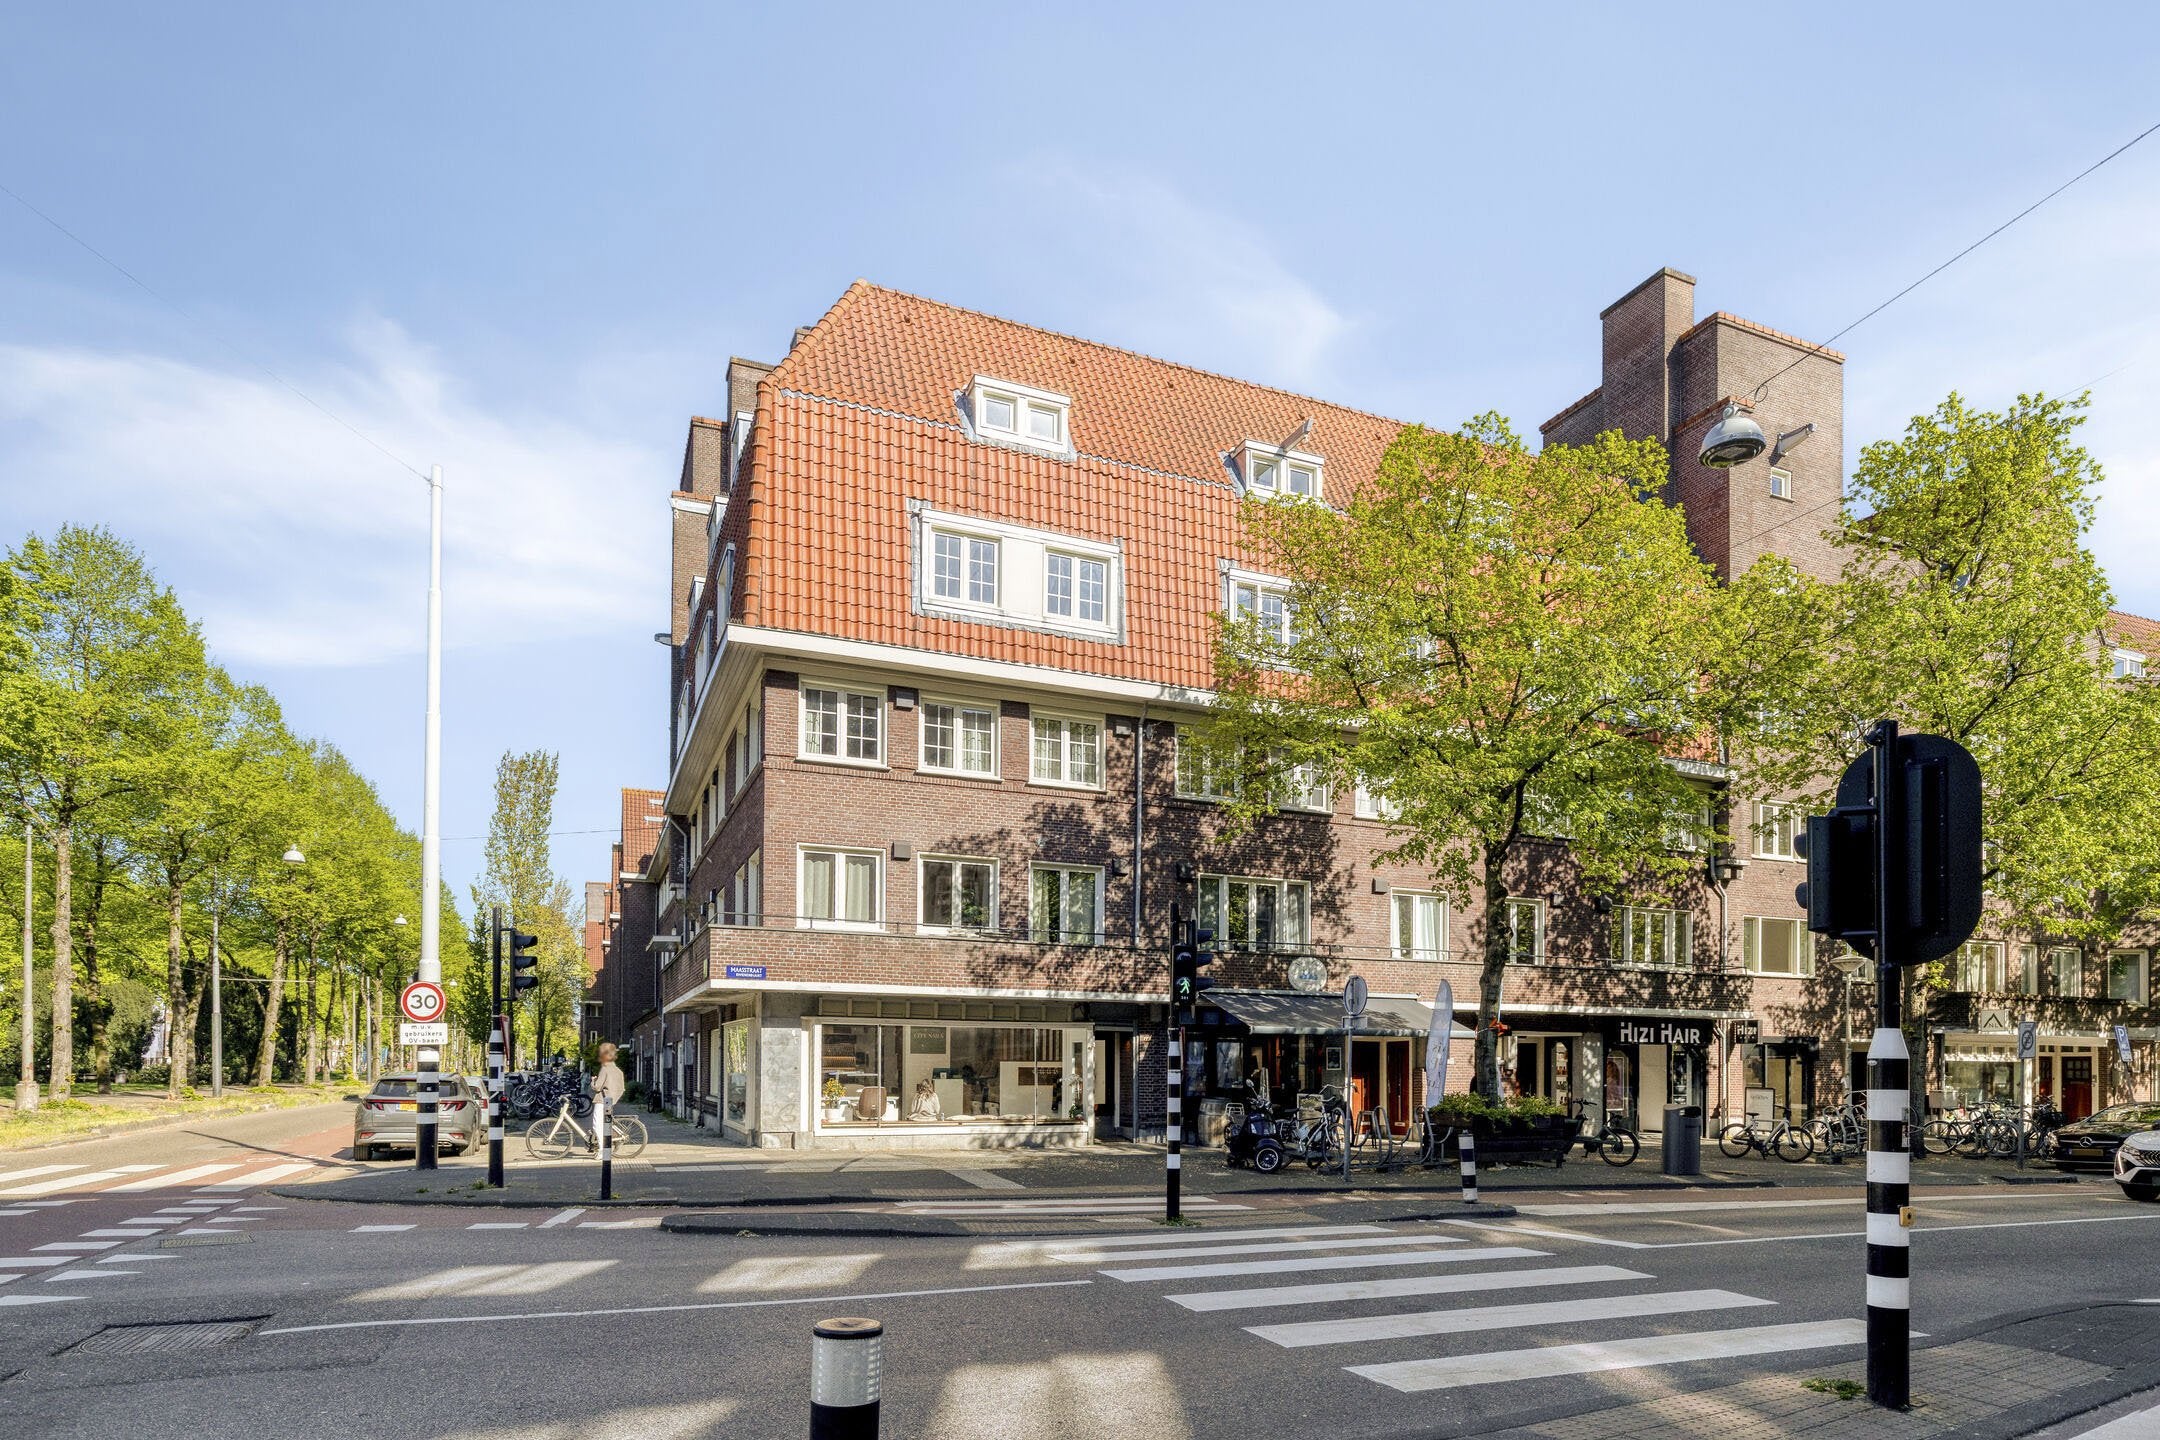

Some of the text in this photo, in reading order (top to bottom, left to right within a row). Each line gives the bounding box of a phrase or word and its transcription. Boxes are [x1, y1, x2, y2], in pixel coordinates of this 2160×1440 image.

[730, 966, 763, 974] MAASSTRAAT
[410, 994, 437, 1009] 30
[1620, 1021, 1701, 1044] HIZI HAIR
[1736, 1024, 1757, 1036] HIZI
[2117, 1028, 2125, 1042] P
